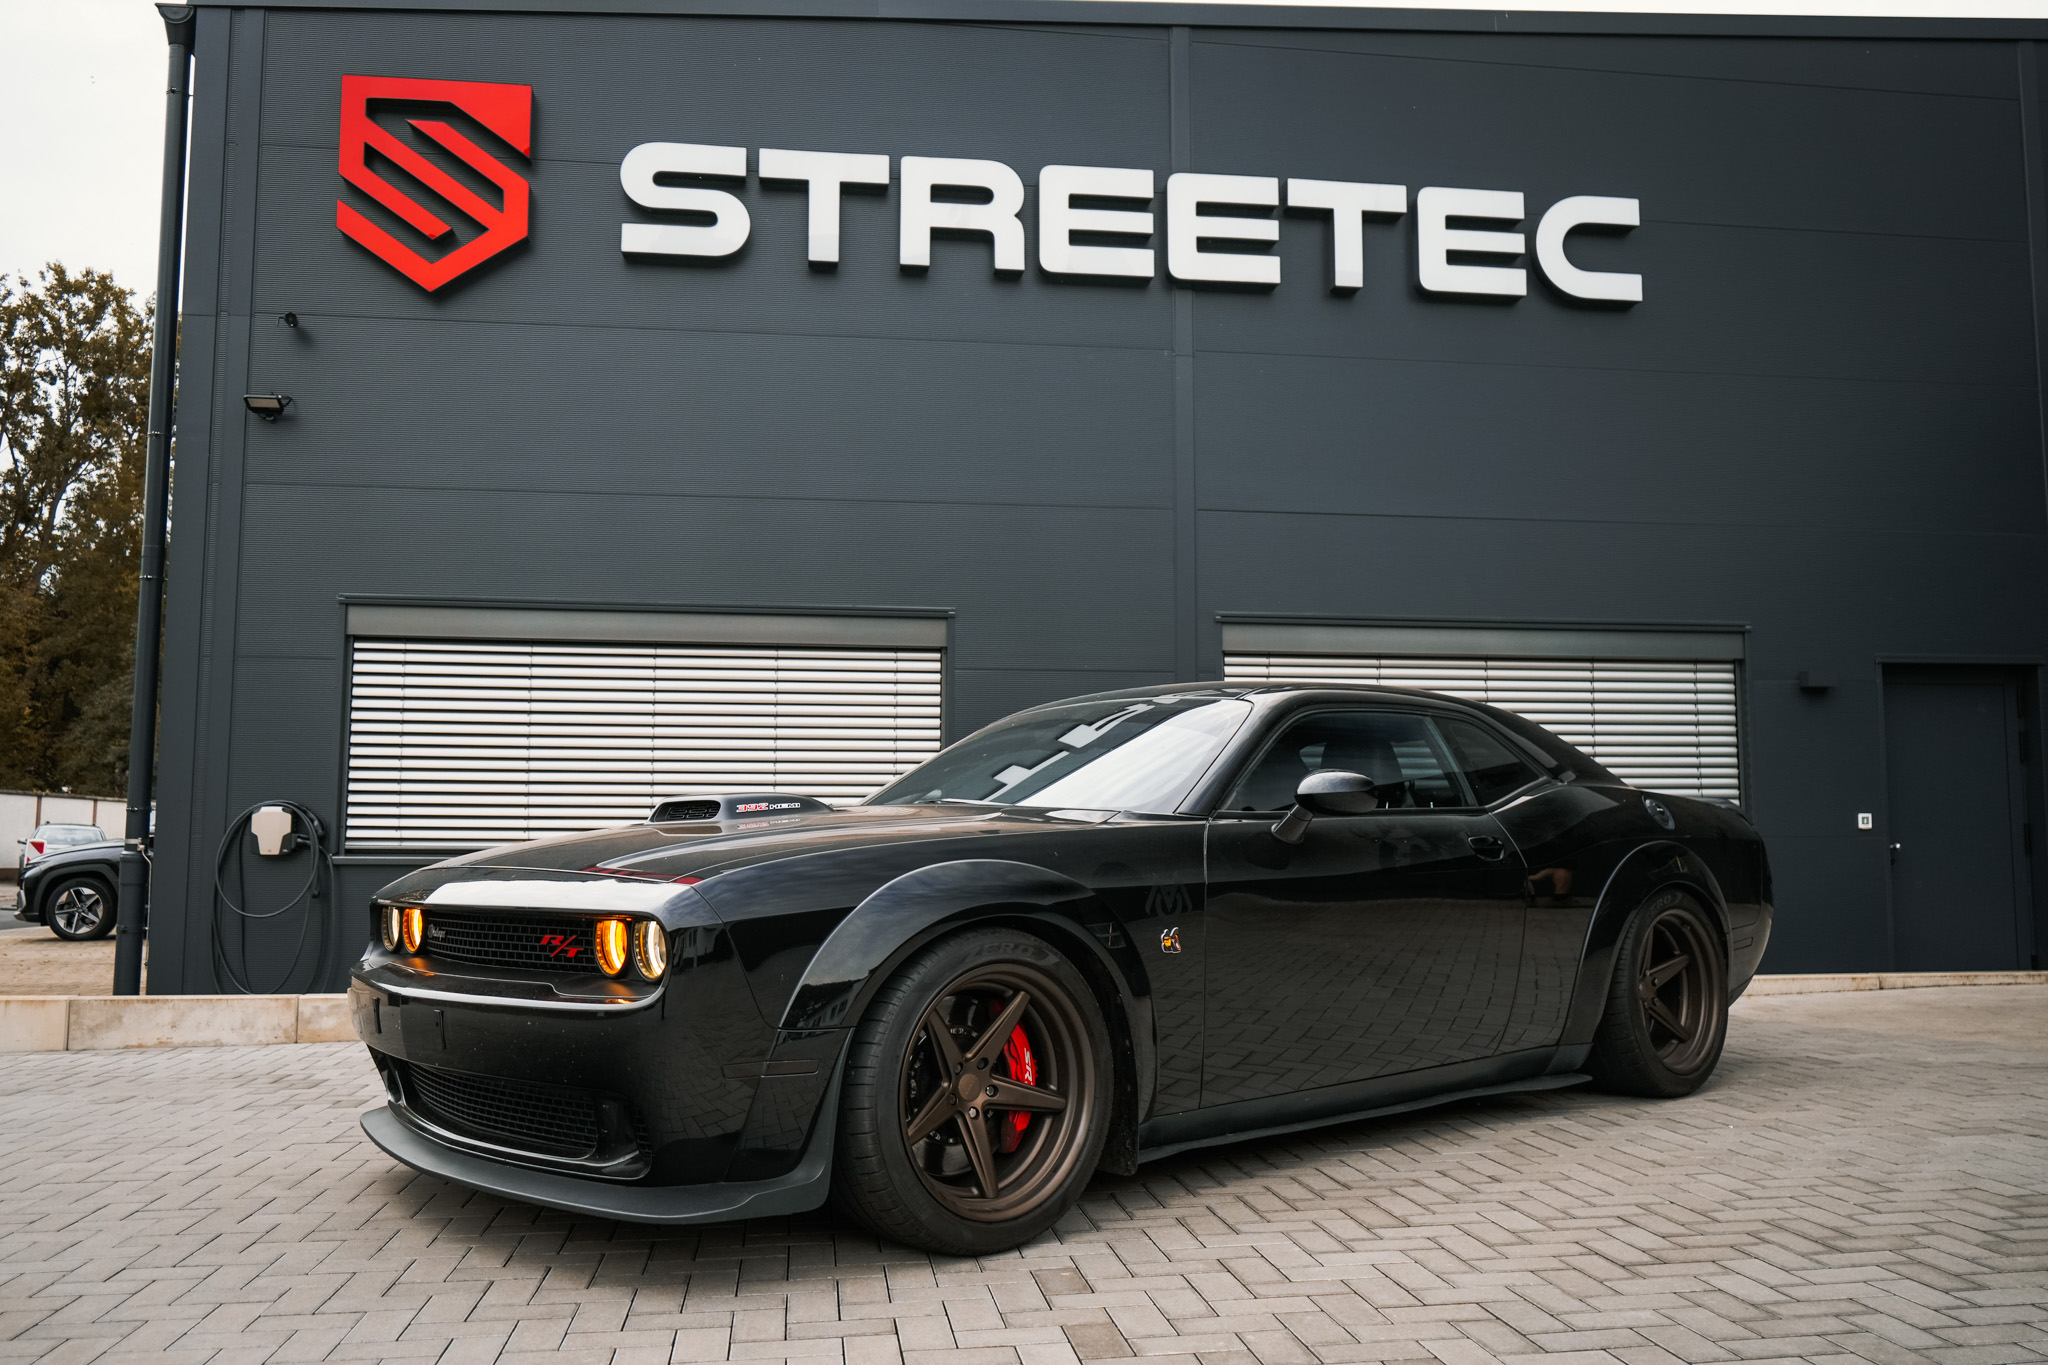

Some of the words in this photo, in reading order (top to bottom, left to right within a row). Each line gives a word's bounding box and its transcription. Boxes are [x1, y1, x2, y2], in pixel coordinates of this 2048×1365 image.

[619, 141, 1644, 303] STREETEC
[737, 803, 768, 812] 392
[540, 935, 584, 957] R/T
[1023, 1047, 1034, 1085] SR
